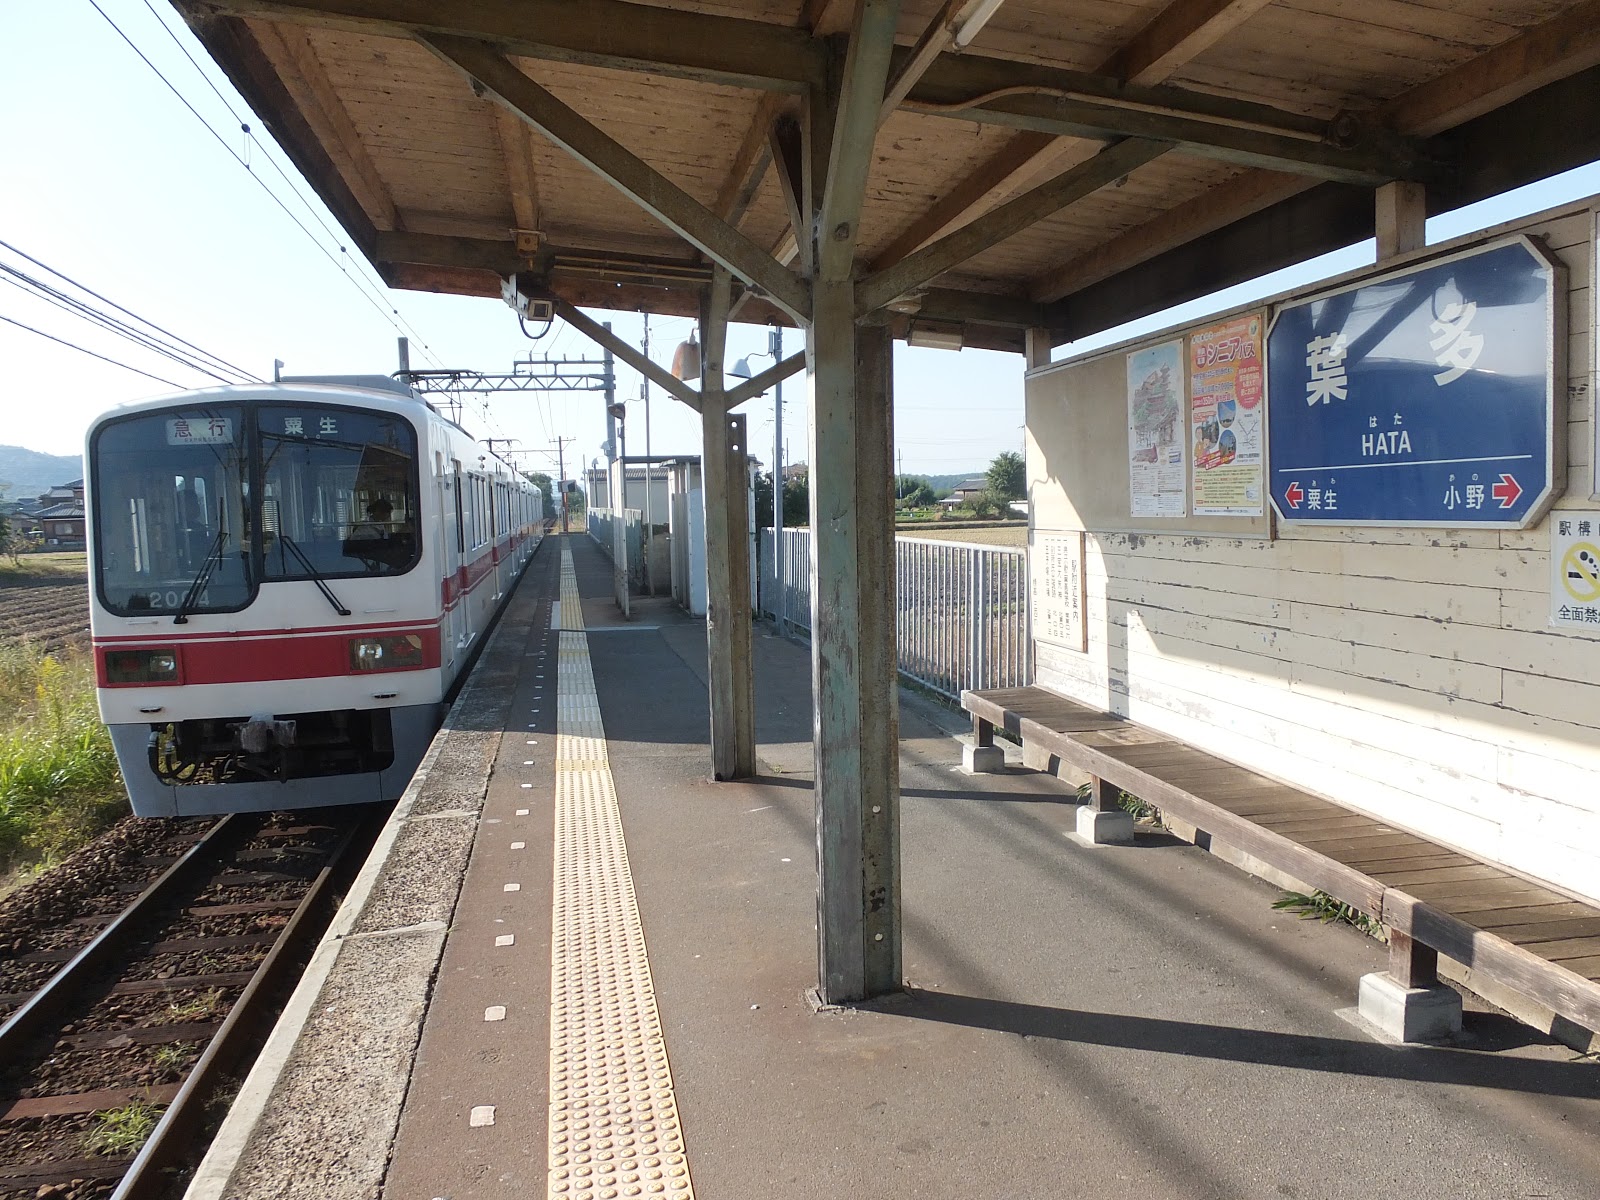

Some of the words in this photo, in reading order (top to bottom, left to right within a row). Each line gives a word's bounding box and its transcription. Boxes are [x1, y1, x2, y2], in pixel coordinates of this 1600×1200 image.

[1306, 301, 1484, 406] 葉多
[174, 417, 226, 438] 急行
[284, 416, 338, 435] 粟生
[1369, 412, 1402, 428] はた
[1362, 430, 1412, 456] HATA
[1307, 488, 1338, 511] 粟生
[1443, 484, 1485, 510] 小野
[1558, 520, 1600, 536] 駅構
[1558, 604, 1600, 624] 全面禁
